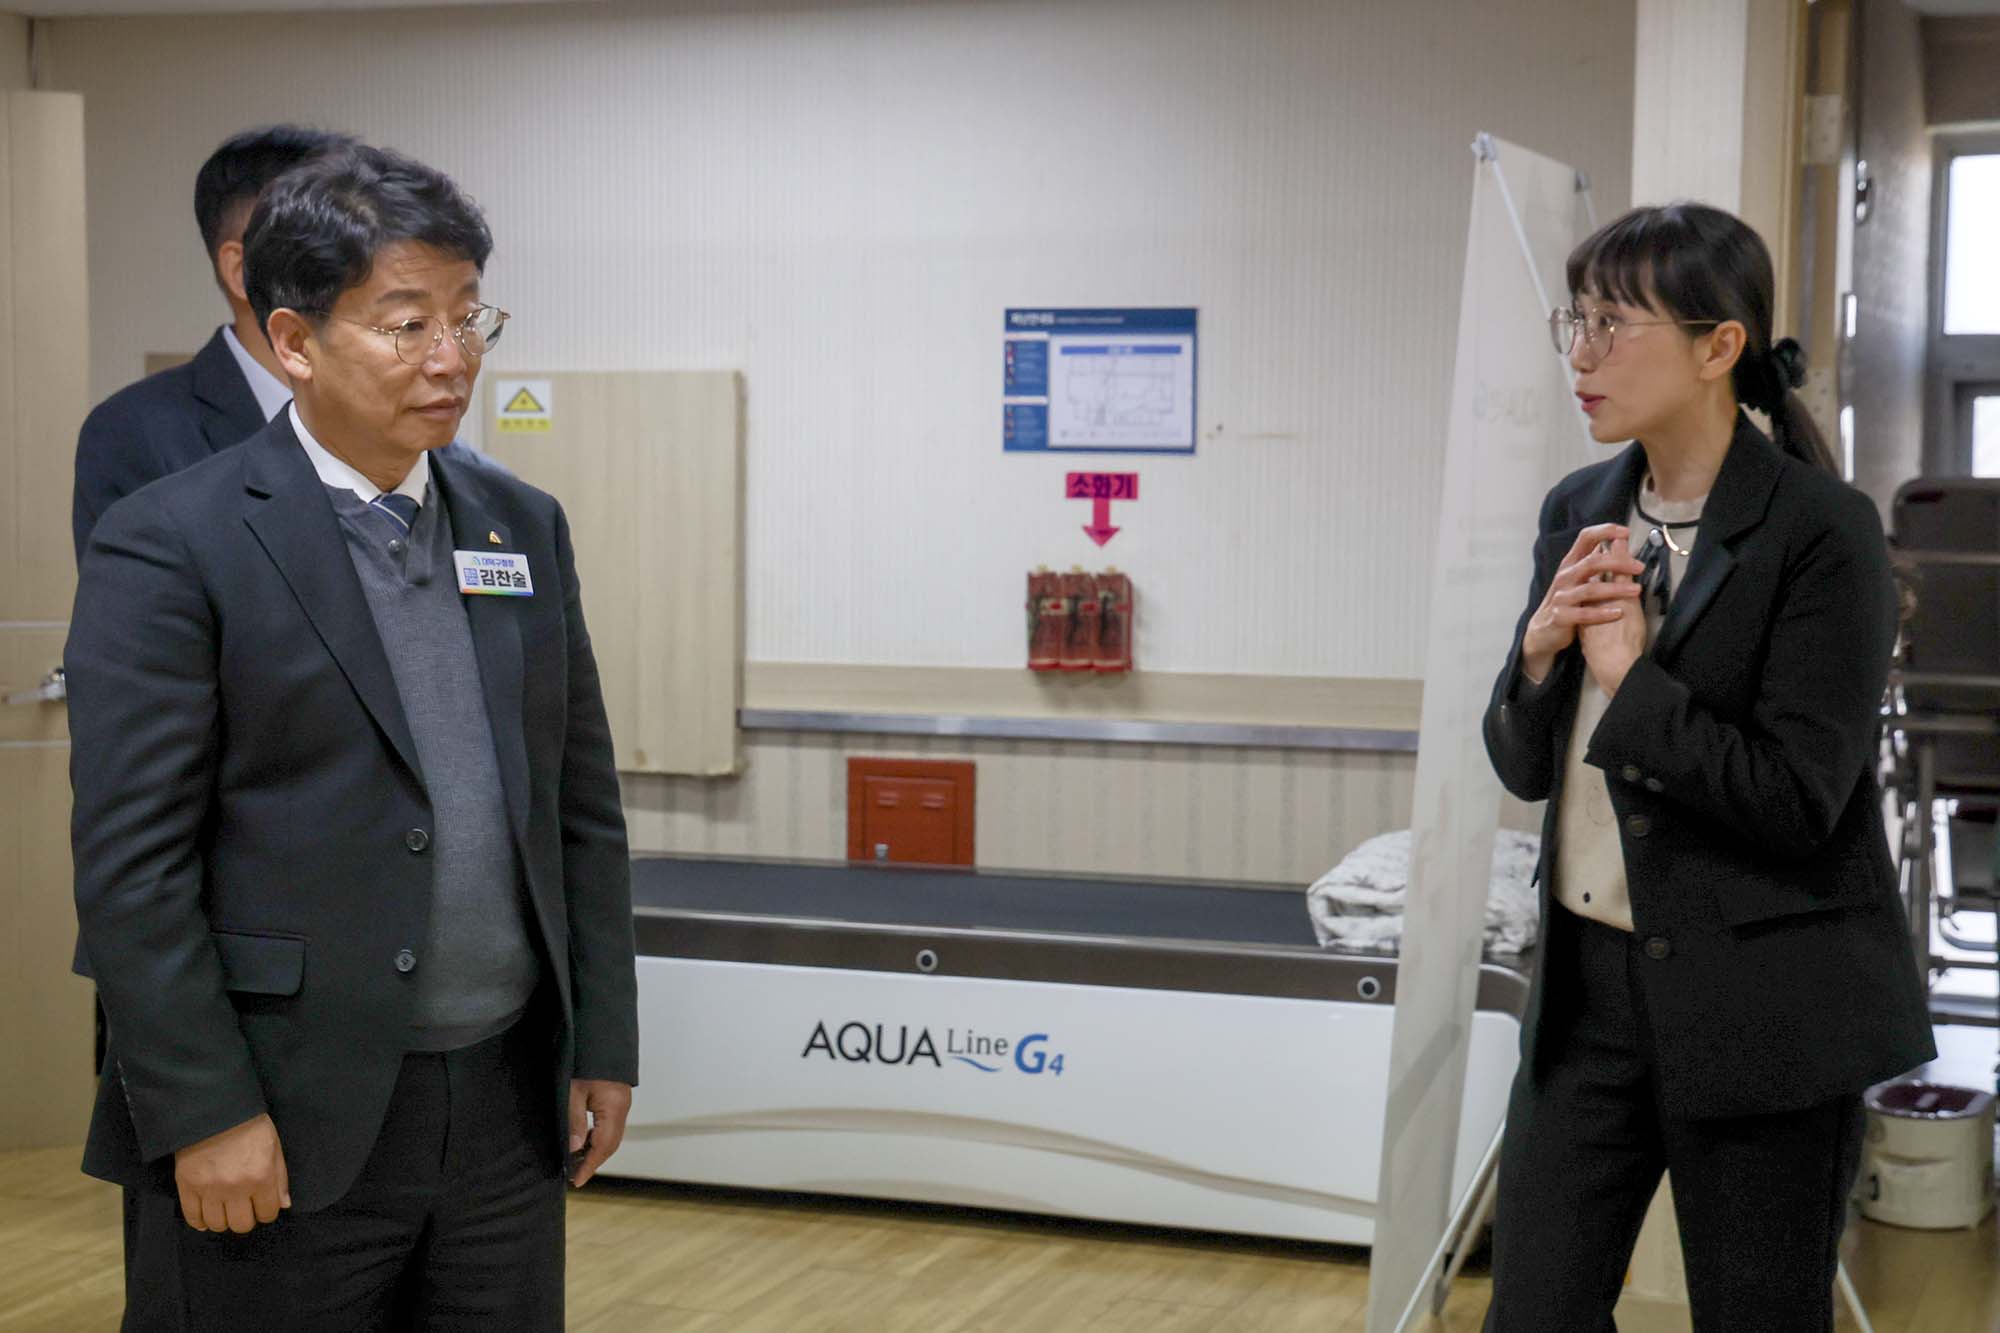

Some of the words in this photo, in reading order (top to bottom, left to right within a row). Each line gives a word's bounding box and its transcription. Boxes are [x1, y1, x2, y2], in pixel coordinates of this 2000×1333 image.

[1071, 473, 1133, 499] 소화기
[479, 569, 527, 588] 김찬술
[801, 1020, 942, 1068] AQUA
[946, 1028, 1009, 1056] Line
[1014, 1033, 1065, 1076] G4
